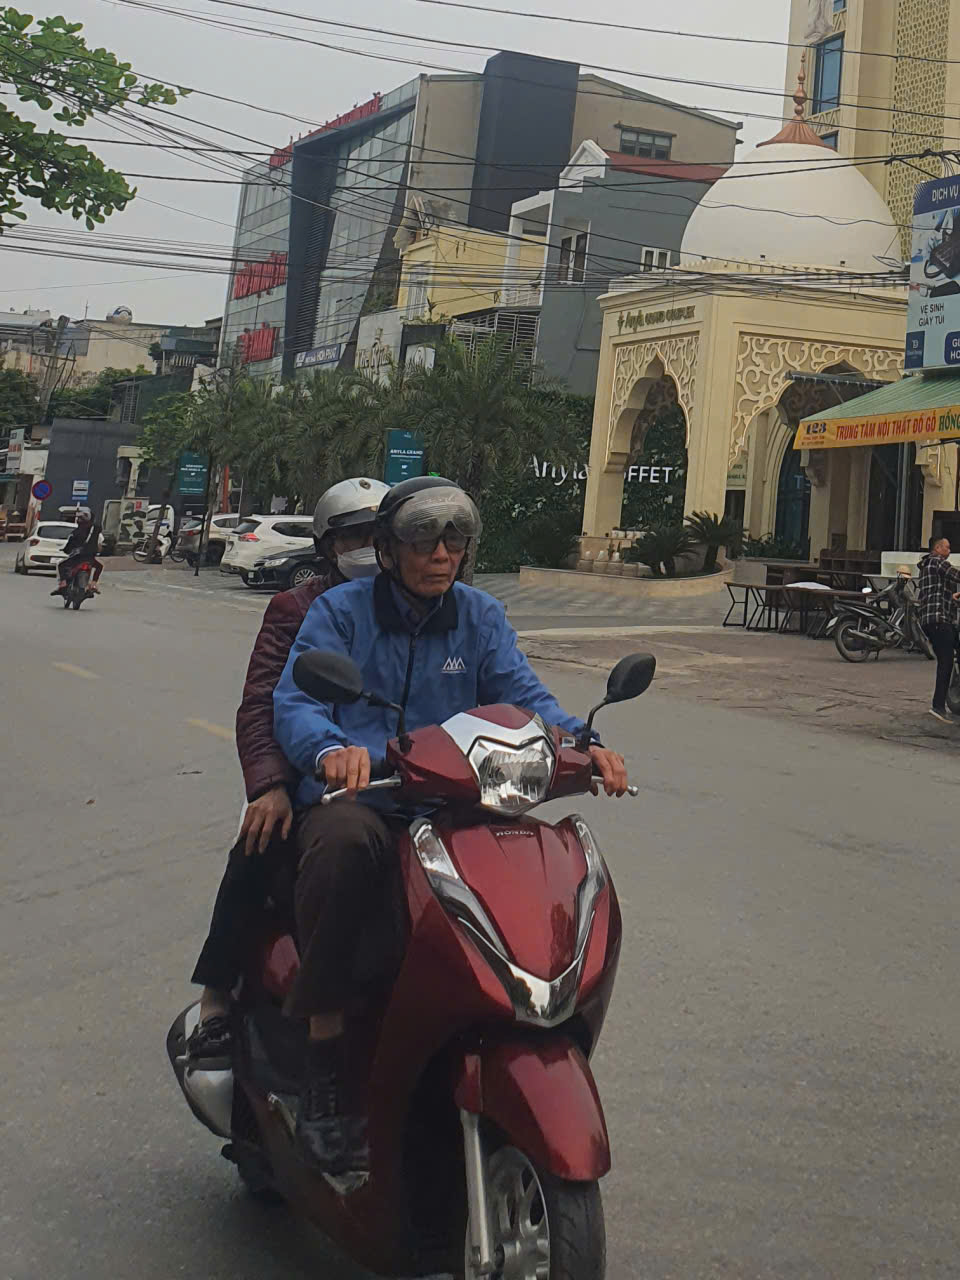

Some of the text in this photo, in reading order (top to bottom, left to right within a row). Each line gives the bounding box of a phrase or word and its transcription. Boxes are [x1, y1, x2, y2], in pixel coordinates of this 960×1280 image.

[929, 302, 945, 313] SINH
[836, 425, 859, 441] TRUNG
[860, 422, 876, 439] TÂM
